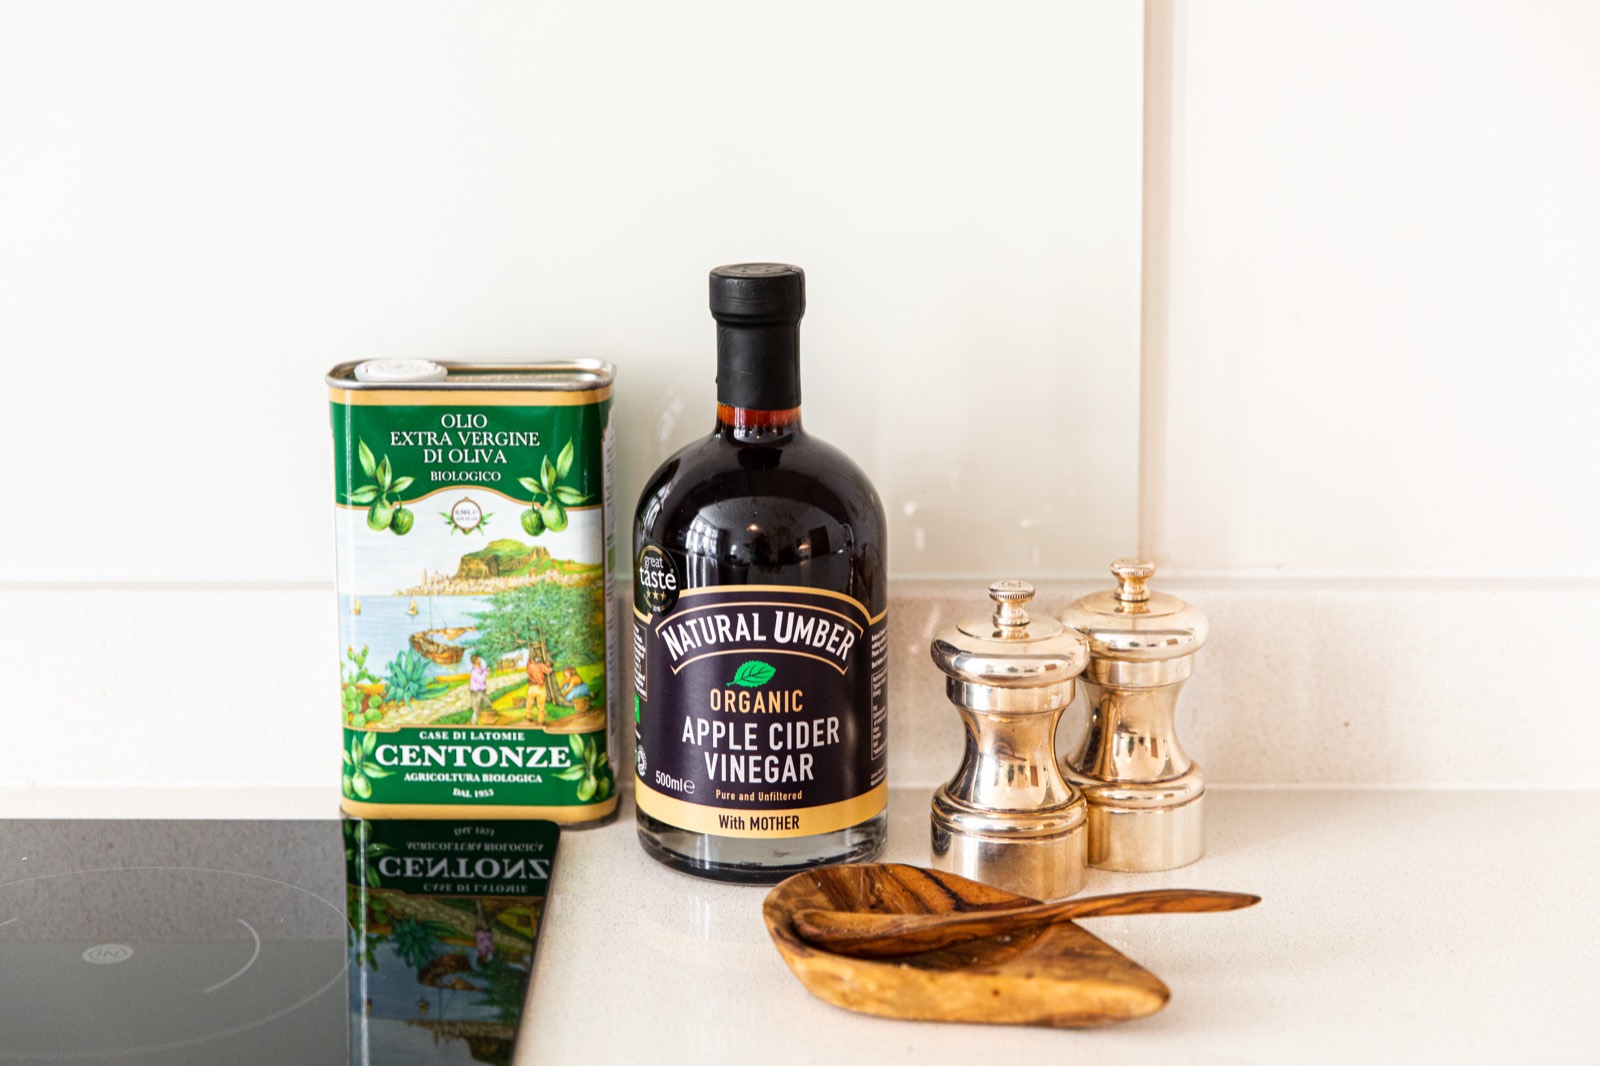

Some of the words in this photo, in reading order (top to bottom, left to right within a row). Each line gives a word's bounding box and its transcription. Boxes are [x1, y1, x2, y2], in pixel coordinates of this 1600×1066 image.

[441, 414, 488, 428] OLIO
[390, 431, 453, 446] EXTRA
[458, 431, 540, 446] VERGINE
[423, 449, 443, 463] DI
[448, 449, 507, 464] OLIVA
[430, 471, 501, 482] BIOLOGICO
[644, 556, 664, 570] great
[661, 612, 767, 661] NATURAL
[774, 610, 856, 662] UMBER
[710, 688, 804, 714] ORGANIC
[419, 730, 449, 740] CASE
[452, 731, 467, 740] DI
[470, 731, 525, 741] LATOMIE
[681, 715, 758, 751] APPLE
[769, 716, 840, 751] CIDER
[375, 744, 571, 768] CENTONZE
[703, 751, 814, 784] VINEGAR
[404, 772, 480, 783] AGRICOLTURA
[482, 773, 542, 784] BIOLOGICA
[453, 788, 472, 798] DAL
[715, 788, 736, 801] Pure
[738, 791, 755, 802] and
[758, 789, 803, 802] Unfiltered
[718, 814, 745, 831] With
[749, 814, 800, 831] MOTHER
